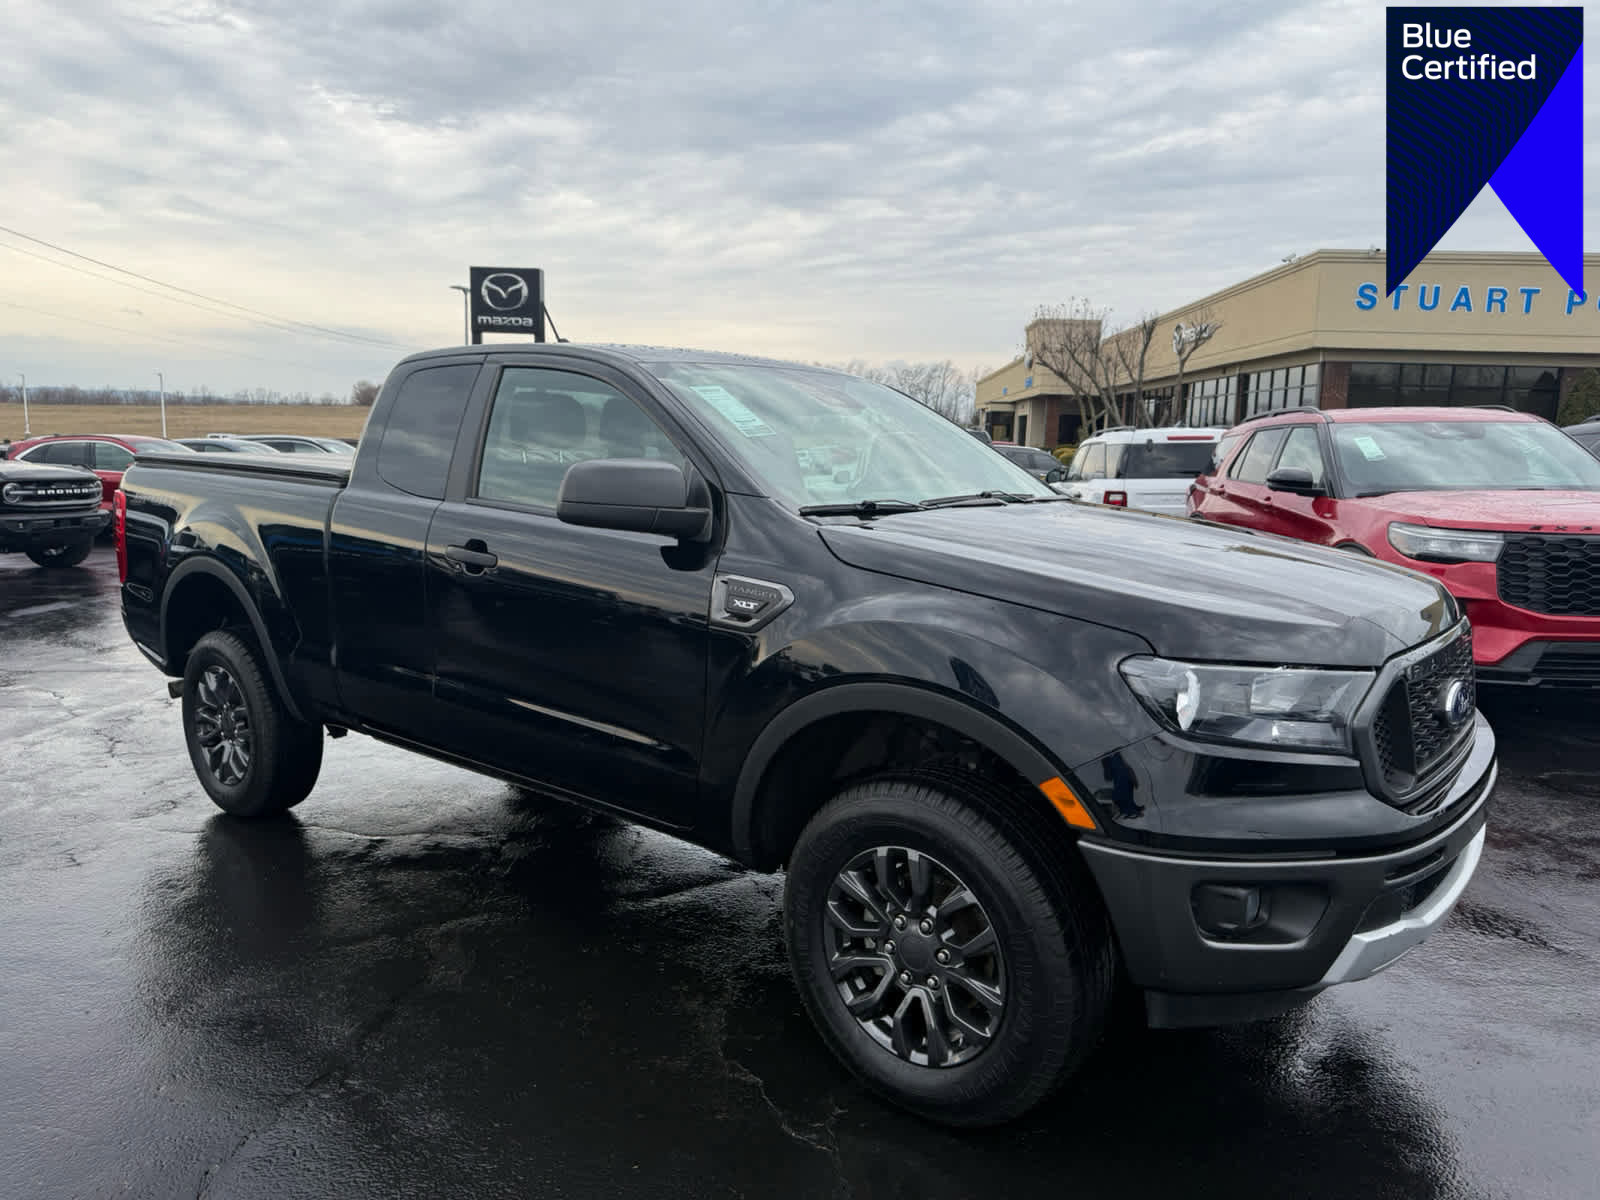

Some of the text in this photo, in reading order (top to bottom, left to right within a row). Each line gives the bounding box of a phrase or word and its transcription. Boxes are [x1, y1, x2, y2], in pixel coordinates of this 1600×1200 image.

[1355, 282, 1541, 314] STUART
[477, 315, 533, 327] mazda
[37, 487, 89, 495] BRONCO
[733, 599, 759, 610] XLT
